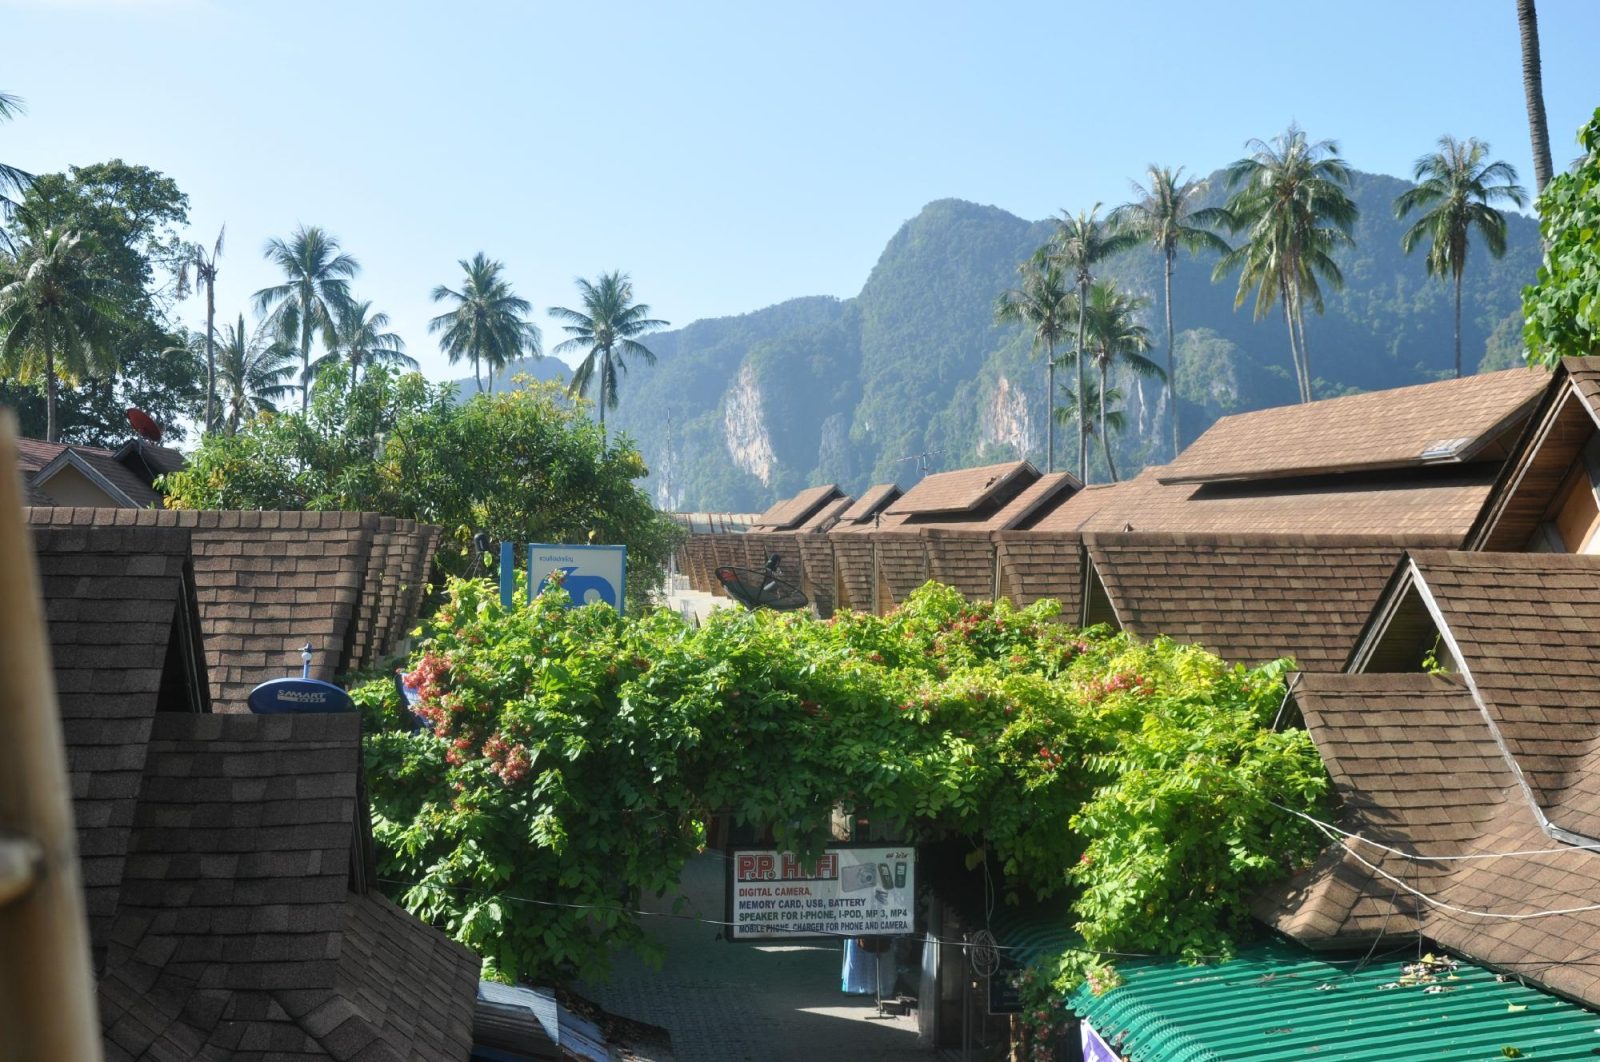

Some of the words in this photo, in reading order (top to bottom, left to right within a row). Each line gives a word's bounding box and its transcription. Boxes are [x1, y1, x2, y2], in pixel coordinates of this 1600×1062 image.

[738, 854, 776, 880] P.P.
[739, 887, 772, 897] DIGITAL
[775, 887, 812, 897] CAMERA,
[739, 900, 776, 910] MEMORY
[778, 899, 804, 910] CARD,
[806, 899, 826, 909] USB,
[828, 898, 866, 908] BATTERY
[739, 912, 779, 922] SPEAKER
[781, 911, 798, 920] FOR
[800, 910, 836, 920] I-PHONE,
[838, 909, 864, 919] I-POD,
[890, 908, 908, 917] MP4
[739, 924, 765, 934] MOBILE
[793, 922, 825, 932] CHARGER
[826, 922, 839, 931] FOR
[841, 921, 864, 931] PHONE
[865, 921, 879, 930] AND
[880, 920, 908, 930] CAMERA
